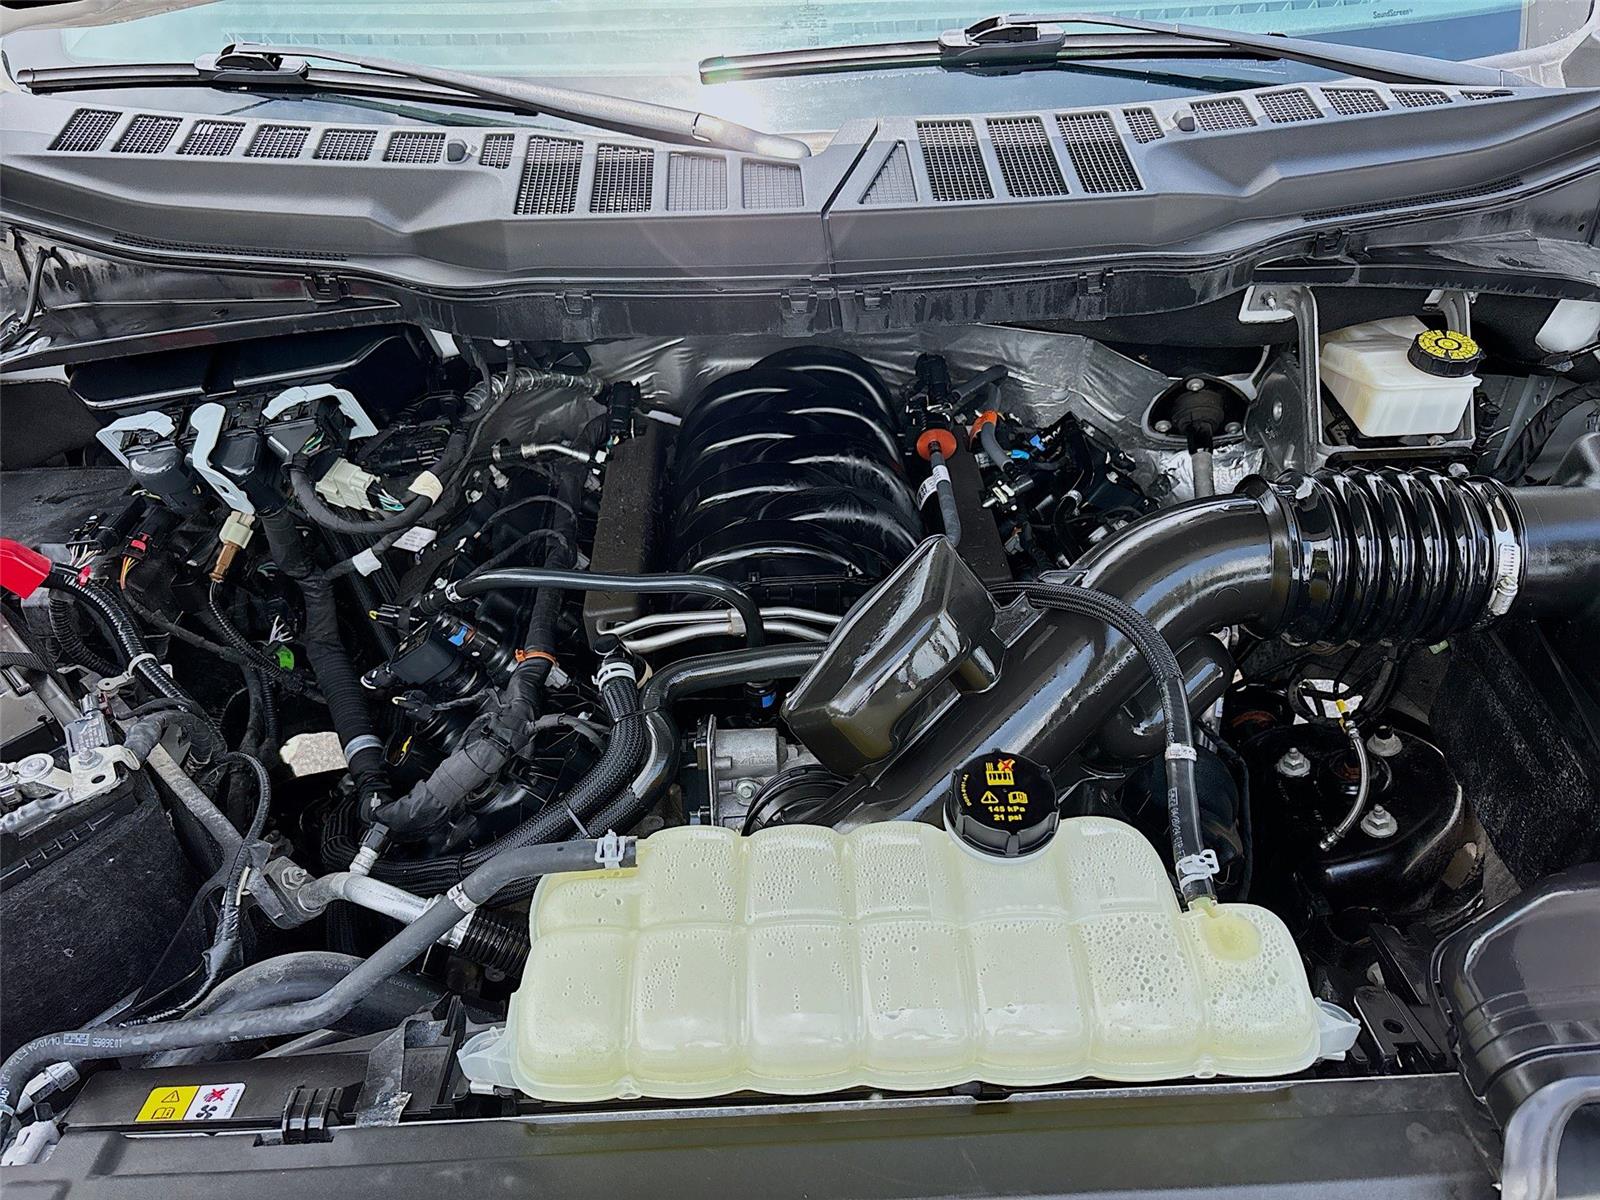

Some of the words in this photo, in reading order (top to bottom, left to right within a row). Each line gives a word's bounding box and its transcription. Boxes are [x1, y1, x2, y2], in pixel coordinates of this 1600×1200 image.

[1007, 805, 1026, 813] kPa
[994, 813, 1005, 821] 21
[1008, 813, 1023, 822] psi
